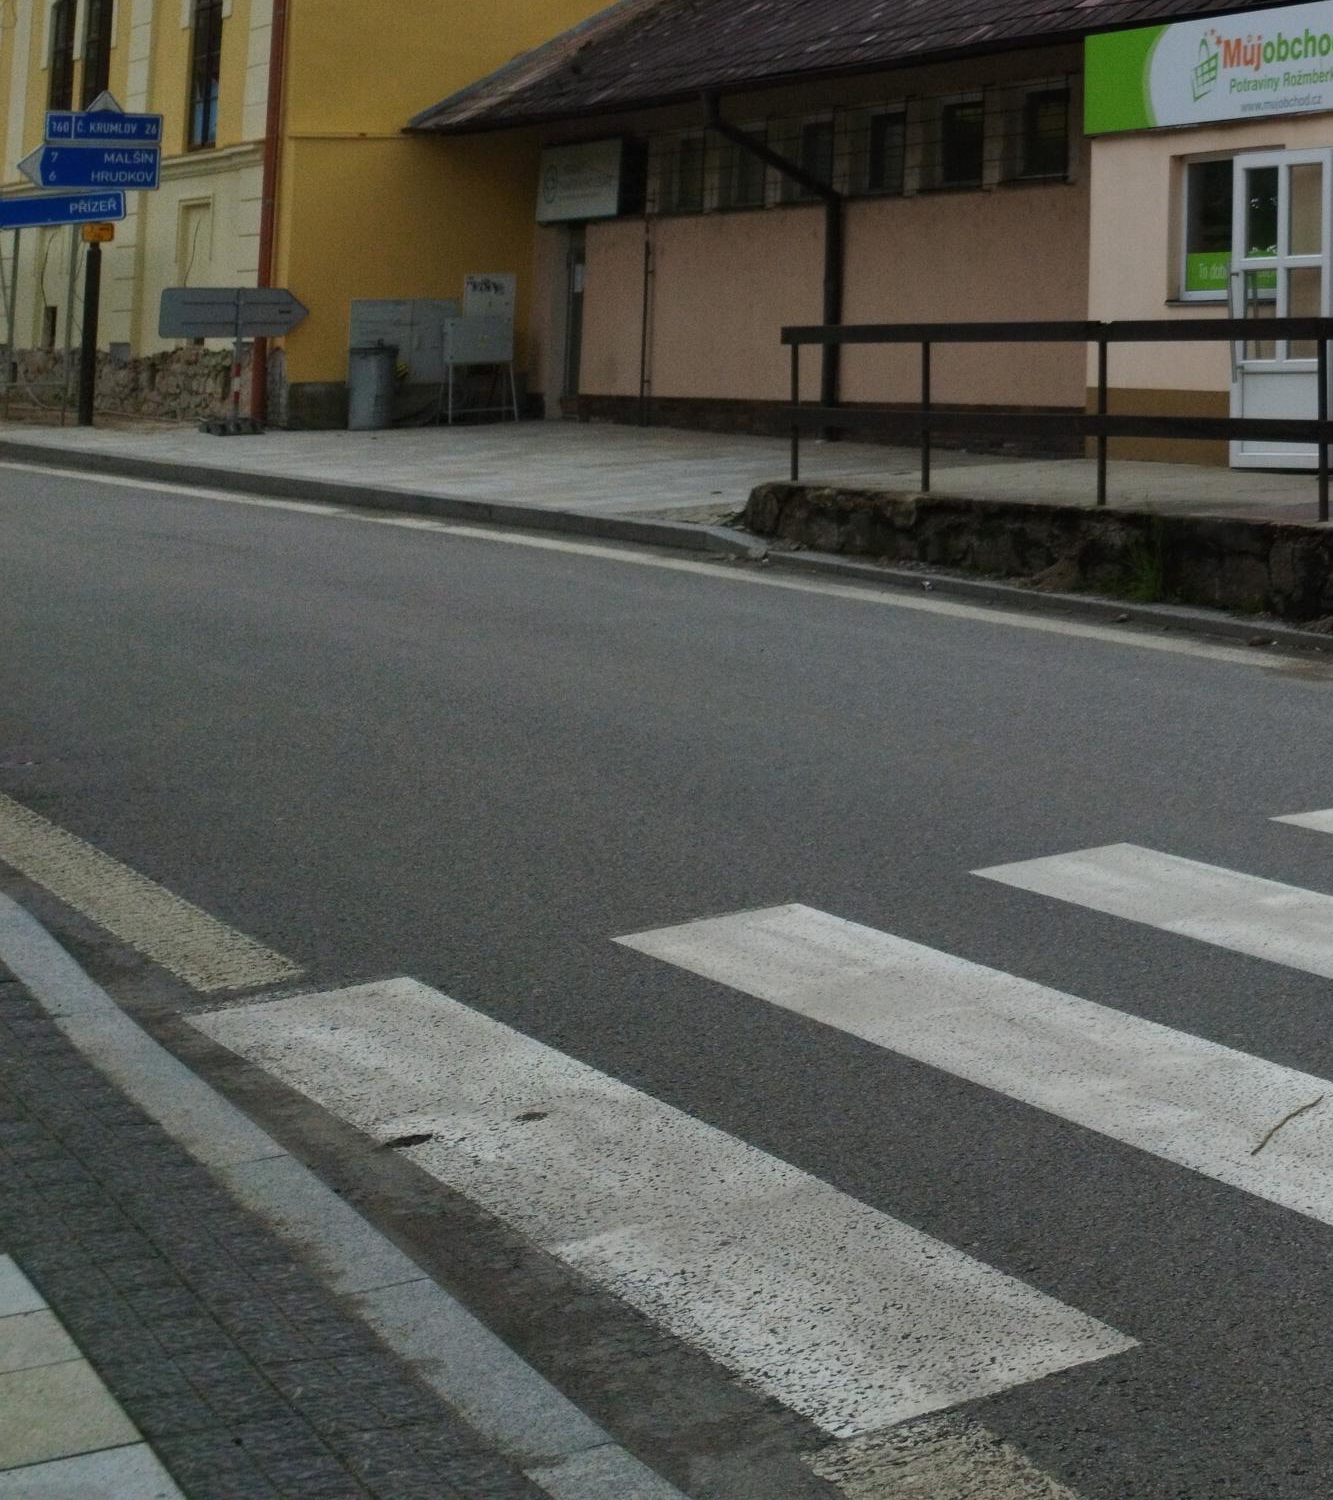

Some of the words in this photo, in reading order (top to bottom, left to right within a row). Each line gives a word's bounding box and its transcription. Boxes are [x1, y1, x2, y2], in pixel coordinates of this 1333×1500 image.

[1229, 75, 1280, 94] Potraviny
[1240, 94, 1323, 112] www.mujobchod.cz
[52, 121, 70, 133] 160
[89, 122, 138, 135] KRUMLOV
[145, 124, 157, 135] 26
[51, 152, 58, 163] 7
[103, 150, 154, 164] MALŠÍN
[49, 171, 57, 181] 6
[91, 171, 154, 182] HRUDKOV
